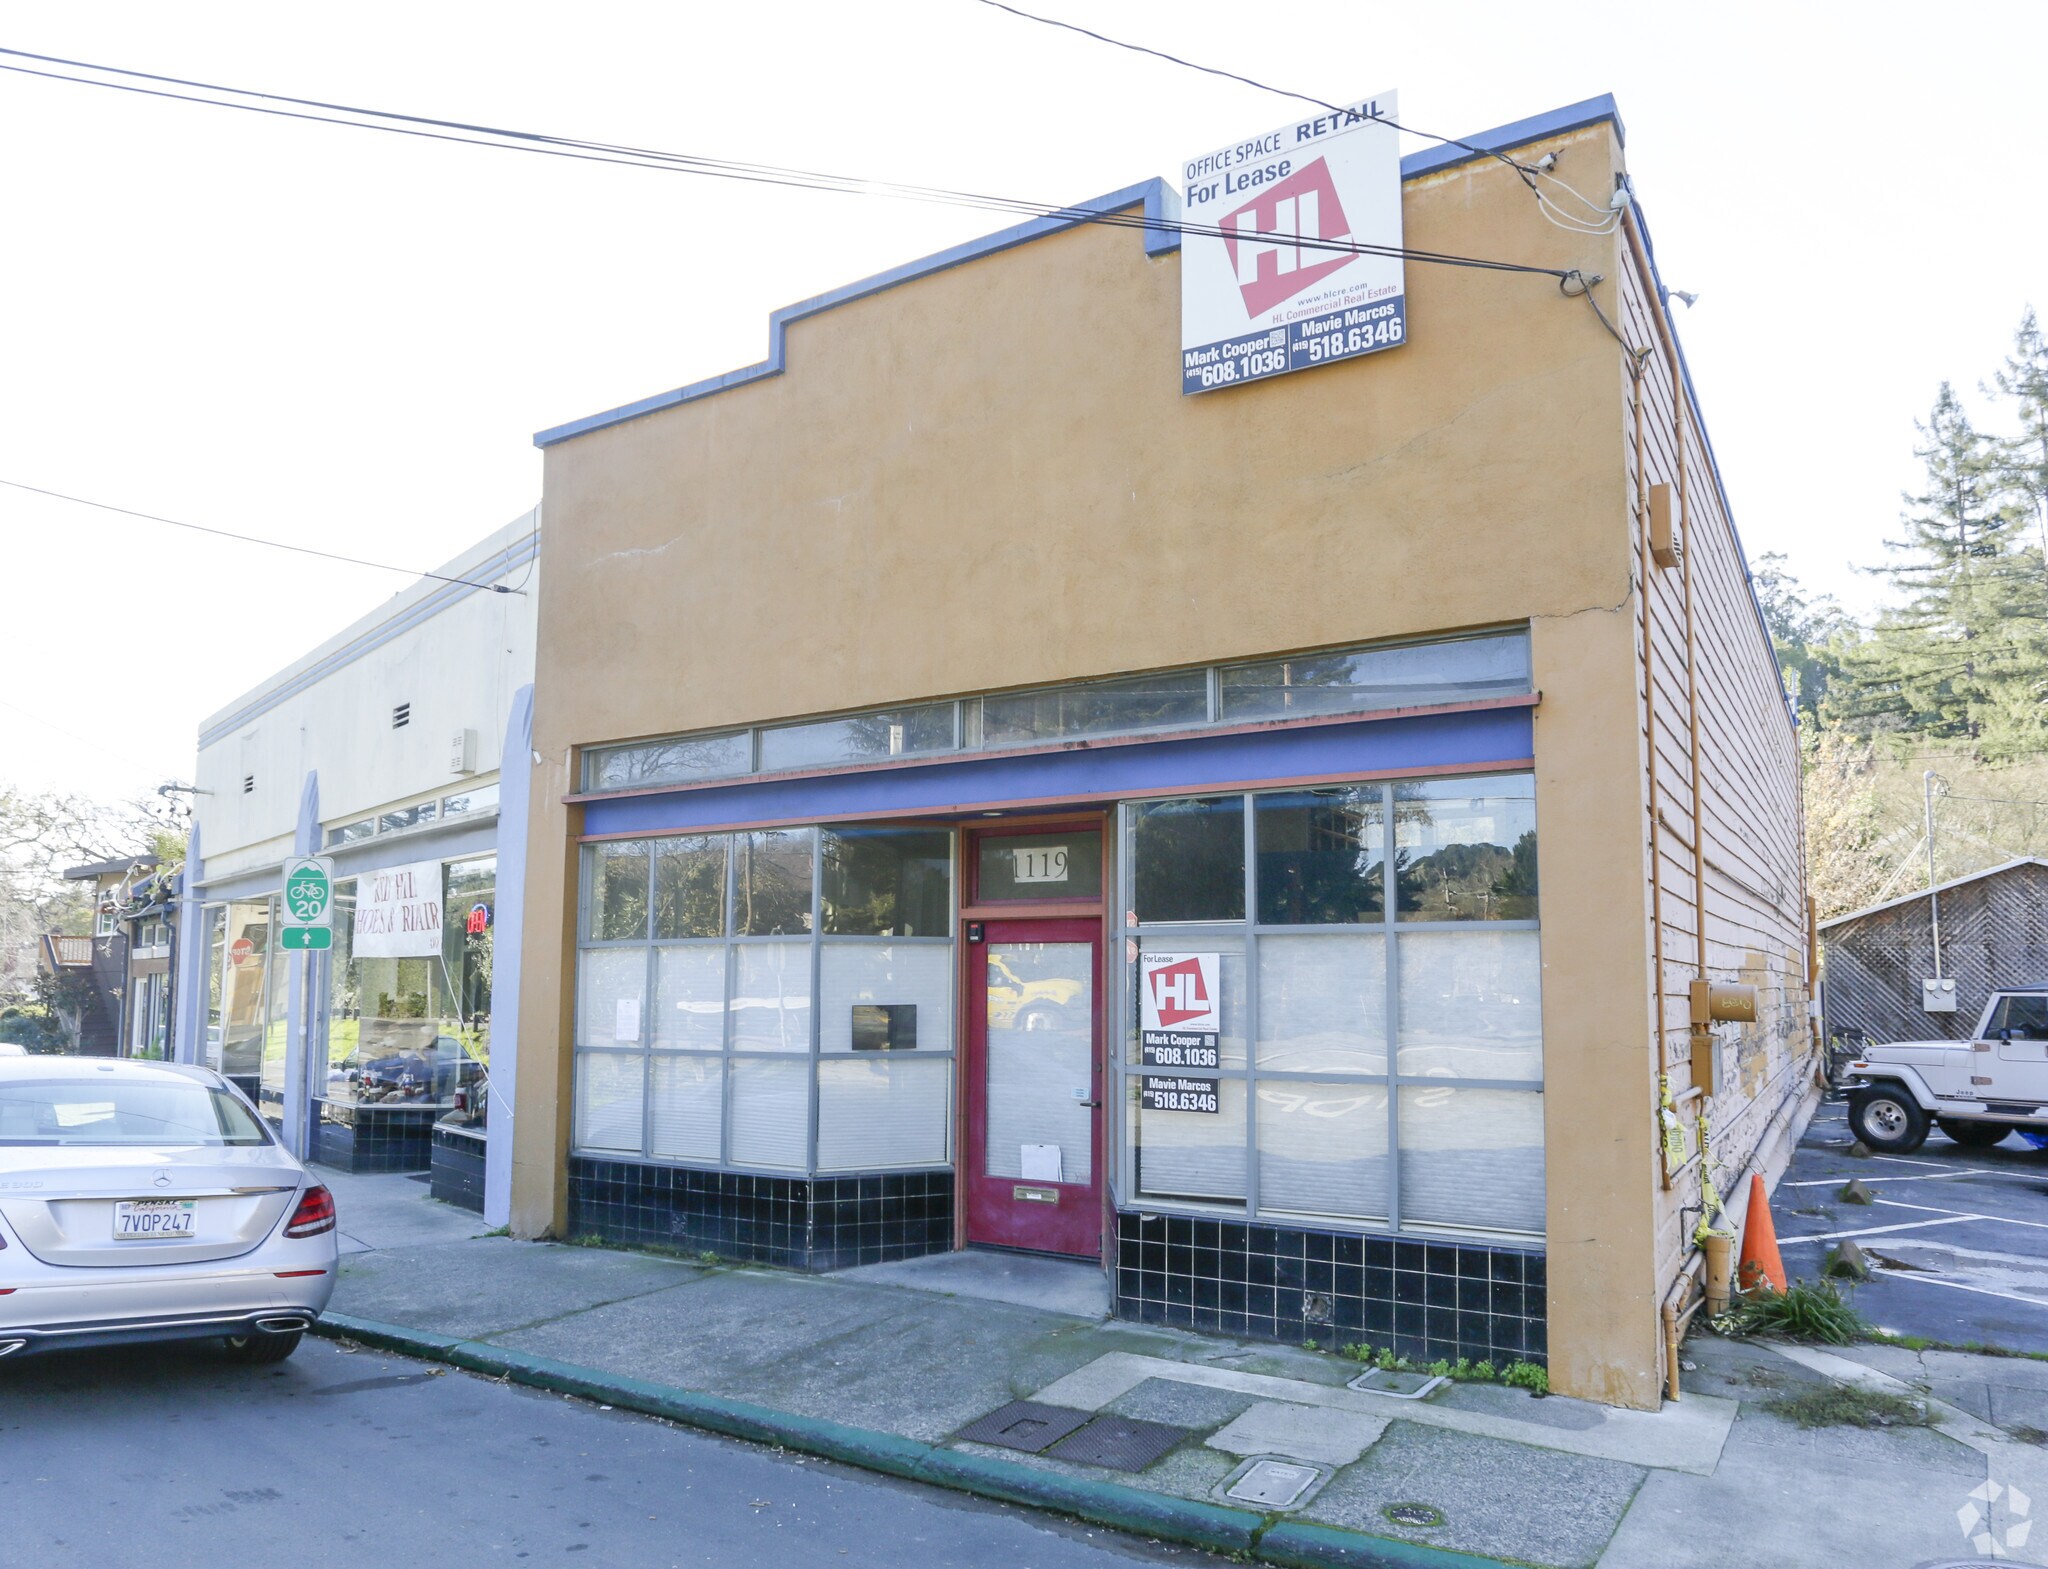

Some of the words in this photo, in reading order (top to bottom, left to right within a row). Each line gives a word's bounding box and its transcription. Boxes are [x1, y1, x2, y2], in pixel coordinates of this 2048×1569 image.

[1187, 149, 1231, 180] OFFICE
[1236, 133, 1281, 163] SPACE
[1296, 100, 1385, 142] RETAIL
[1187, 183, 1219, 207] For
[1225, 159, 1291, 195] Lease
[1236, 189, 1353, 284] HL
[1272, 308, 1285, 324] HL
[1286, 296, 1341, 320] Commercial
[1344, 291, 1365, 306] Real
[1368, 285, 1397, 300] Estate
[1302, 316, 1342, 338] Mavie
[1345, 303, 1395, 328] Marcos
[1185, 345, 1219, 368] Mark
[1222, 337, 1270, 360] Cooper
[1309, 317, 1402, 361] 518.6346
[1201, 348, 1286, 387] 608.1036
[1012, 851, 1068, 878] 1119
[296, 900, 322, 917] 20
[1143, 955, 1154, 963] For
[1154, 955, 1173, 963] Lease
[1156, 973, 1210, 1011] HL
[1146, 1033, 1169, 1045] Mark
[1170, 1034, 1201, 1047] Cooper
[1155, 1047, 1217, 1066] 608.1036
[1149, 1077, 1176, 1090] Mavie
[1177, 1079, 1211, 1092] Marcos
[1154, 1091, 1217, 1112] 518.6346
